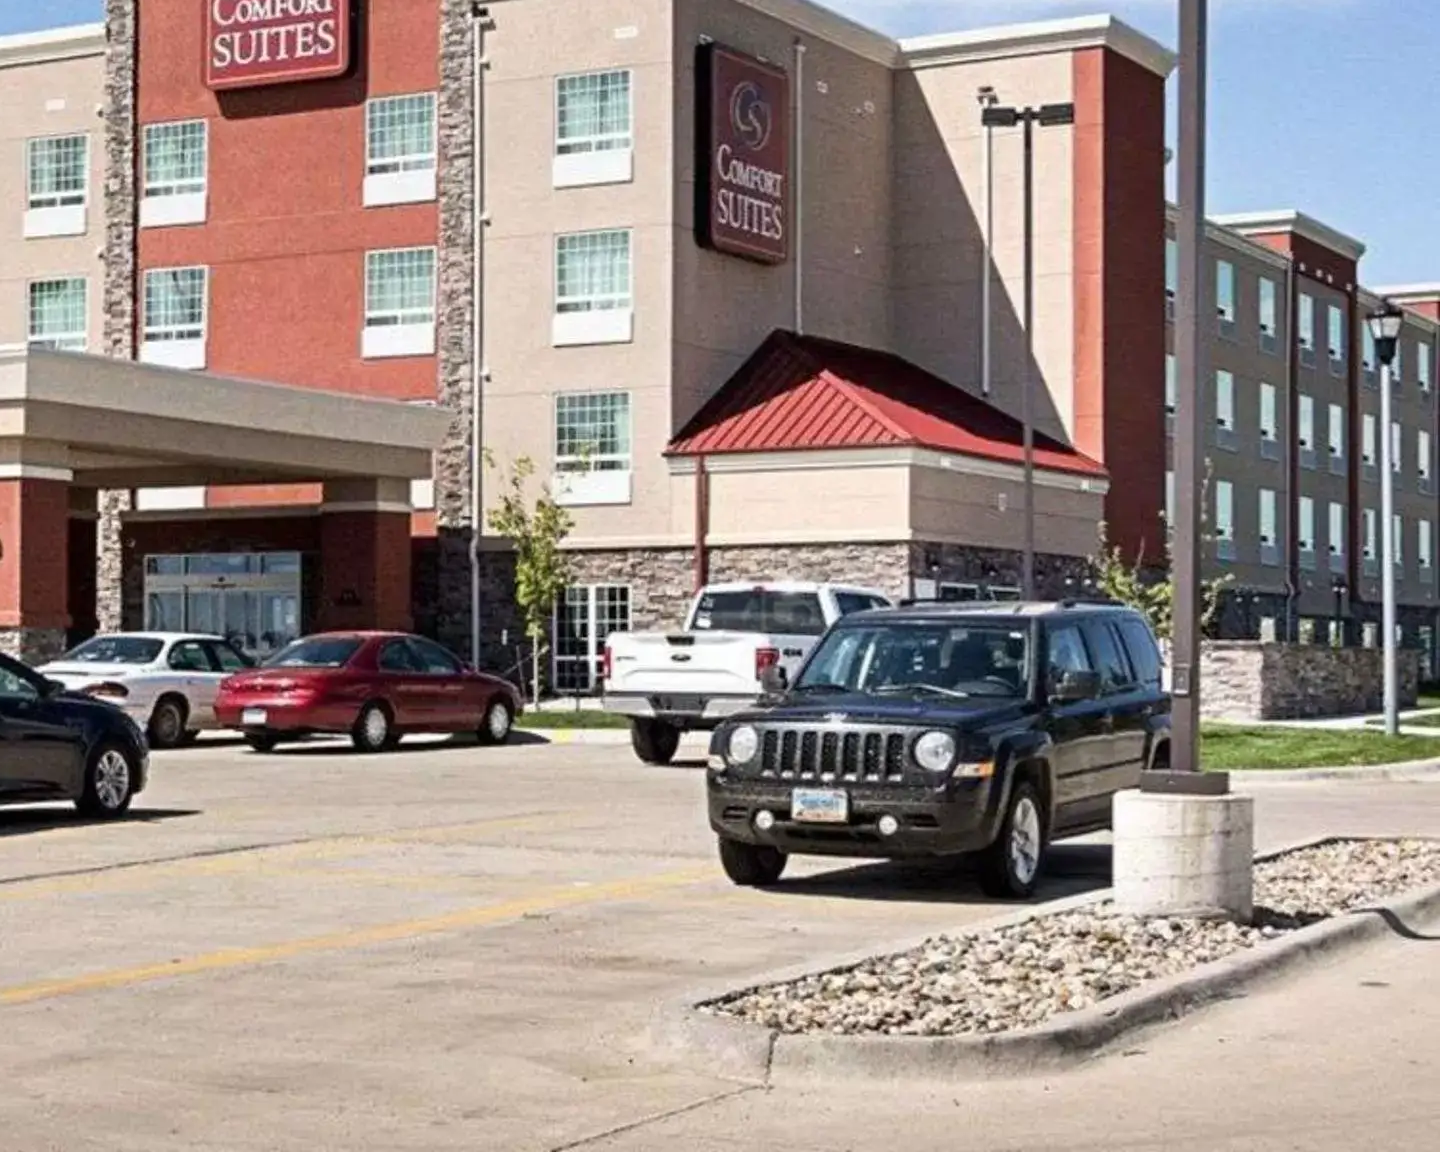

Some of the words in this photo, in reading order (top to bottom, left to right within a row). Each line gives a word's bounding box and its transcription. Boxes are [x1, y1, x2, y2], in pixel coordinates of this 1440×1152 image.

[213, 19, 336, 67] SUITES
[716, 143, 783, 197] COMFORT
[717, 188, 783, 240] SUITES
